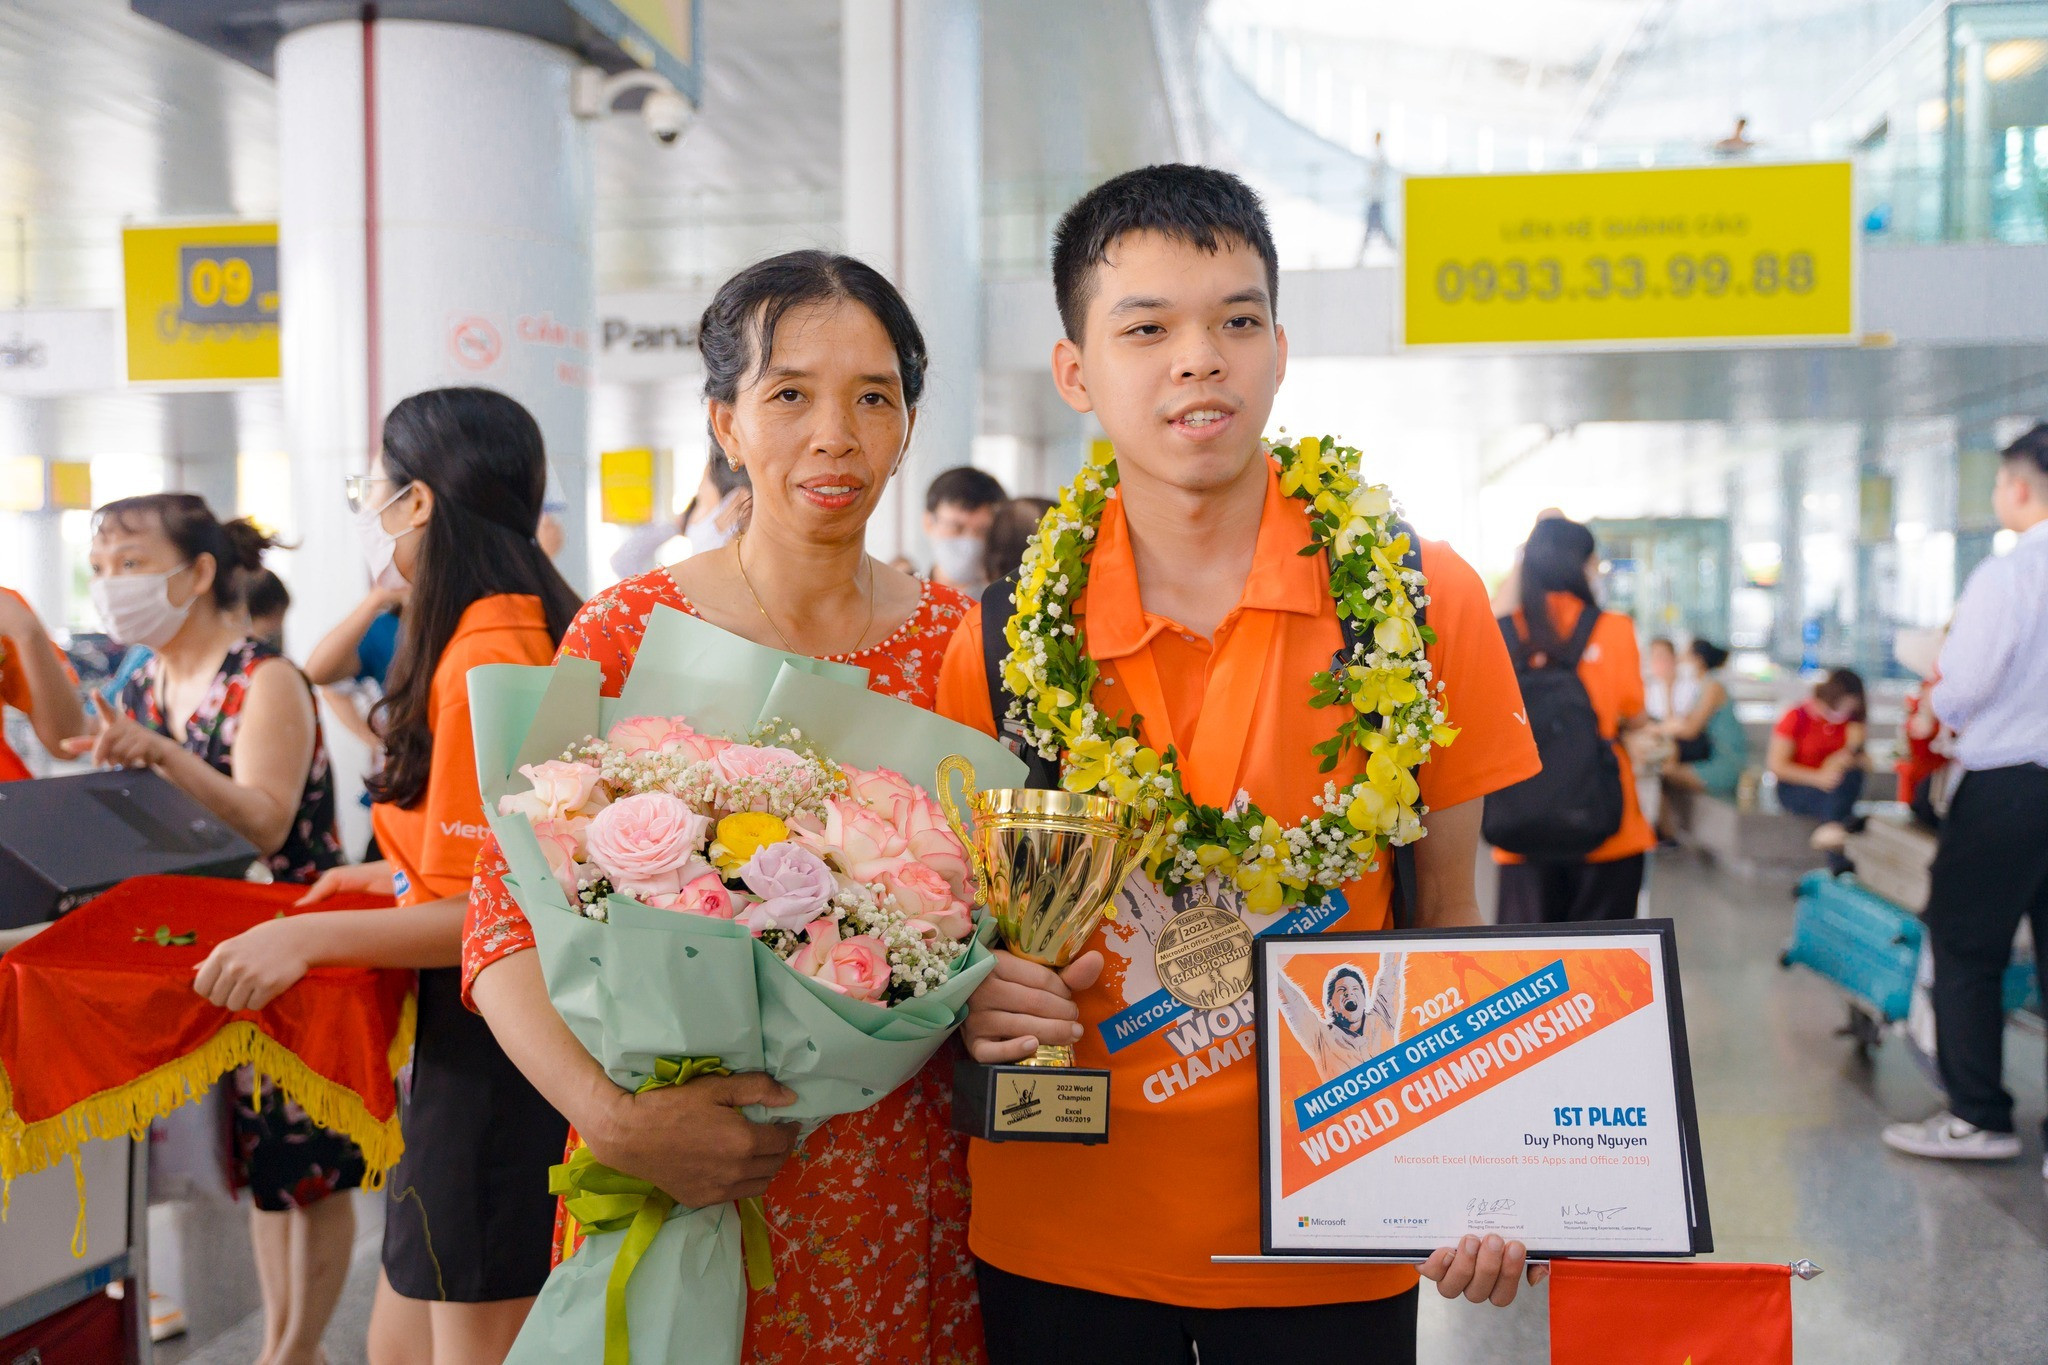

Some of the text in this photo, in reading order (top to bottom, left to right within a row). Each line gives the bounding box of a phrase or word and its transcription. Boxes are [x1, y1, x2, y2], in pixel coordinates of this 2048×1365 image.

[190, 257, 253, 307] 09
[1436, 250, 1816, 302] 0933.33.99.88
[1160, 924, 1241, 960] Microsoft Office Specialist
[1183, 921, 1209, 937] 2022
[1170, 945, 1252, 986] CHAMPIONSHIP
[1176, 939, 1234, 971] WORLD
[1411, 987, 1465, 1026] 2022
[1304, 973, 1559, 1118] MICROSOFT OFFICE SPECIALIST
[1142, 1030, 1256, 1104] CHAMP
[1299, 992, 1596, 1167] WORLD CHAMPIONSHIP
[1057, 1094, 1091, 1102] Champion
[1055, 1115, 1091, 1123] O365/2019
[1553, 1107, 1648, 1126] 1ST PLACE
[1524, 1133, 1648, 1149] Duy Phong Nguyen
[1394, 1155, 1650, 1167] Microsoft Excel (Microsoft 365 Apps and Office 2019)
[1311, 1218, 1346, 1226] Microsoft
[1383, 1216, 1429, 1224] CERTIPORT
